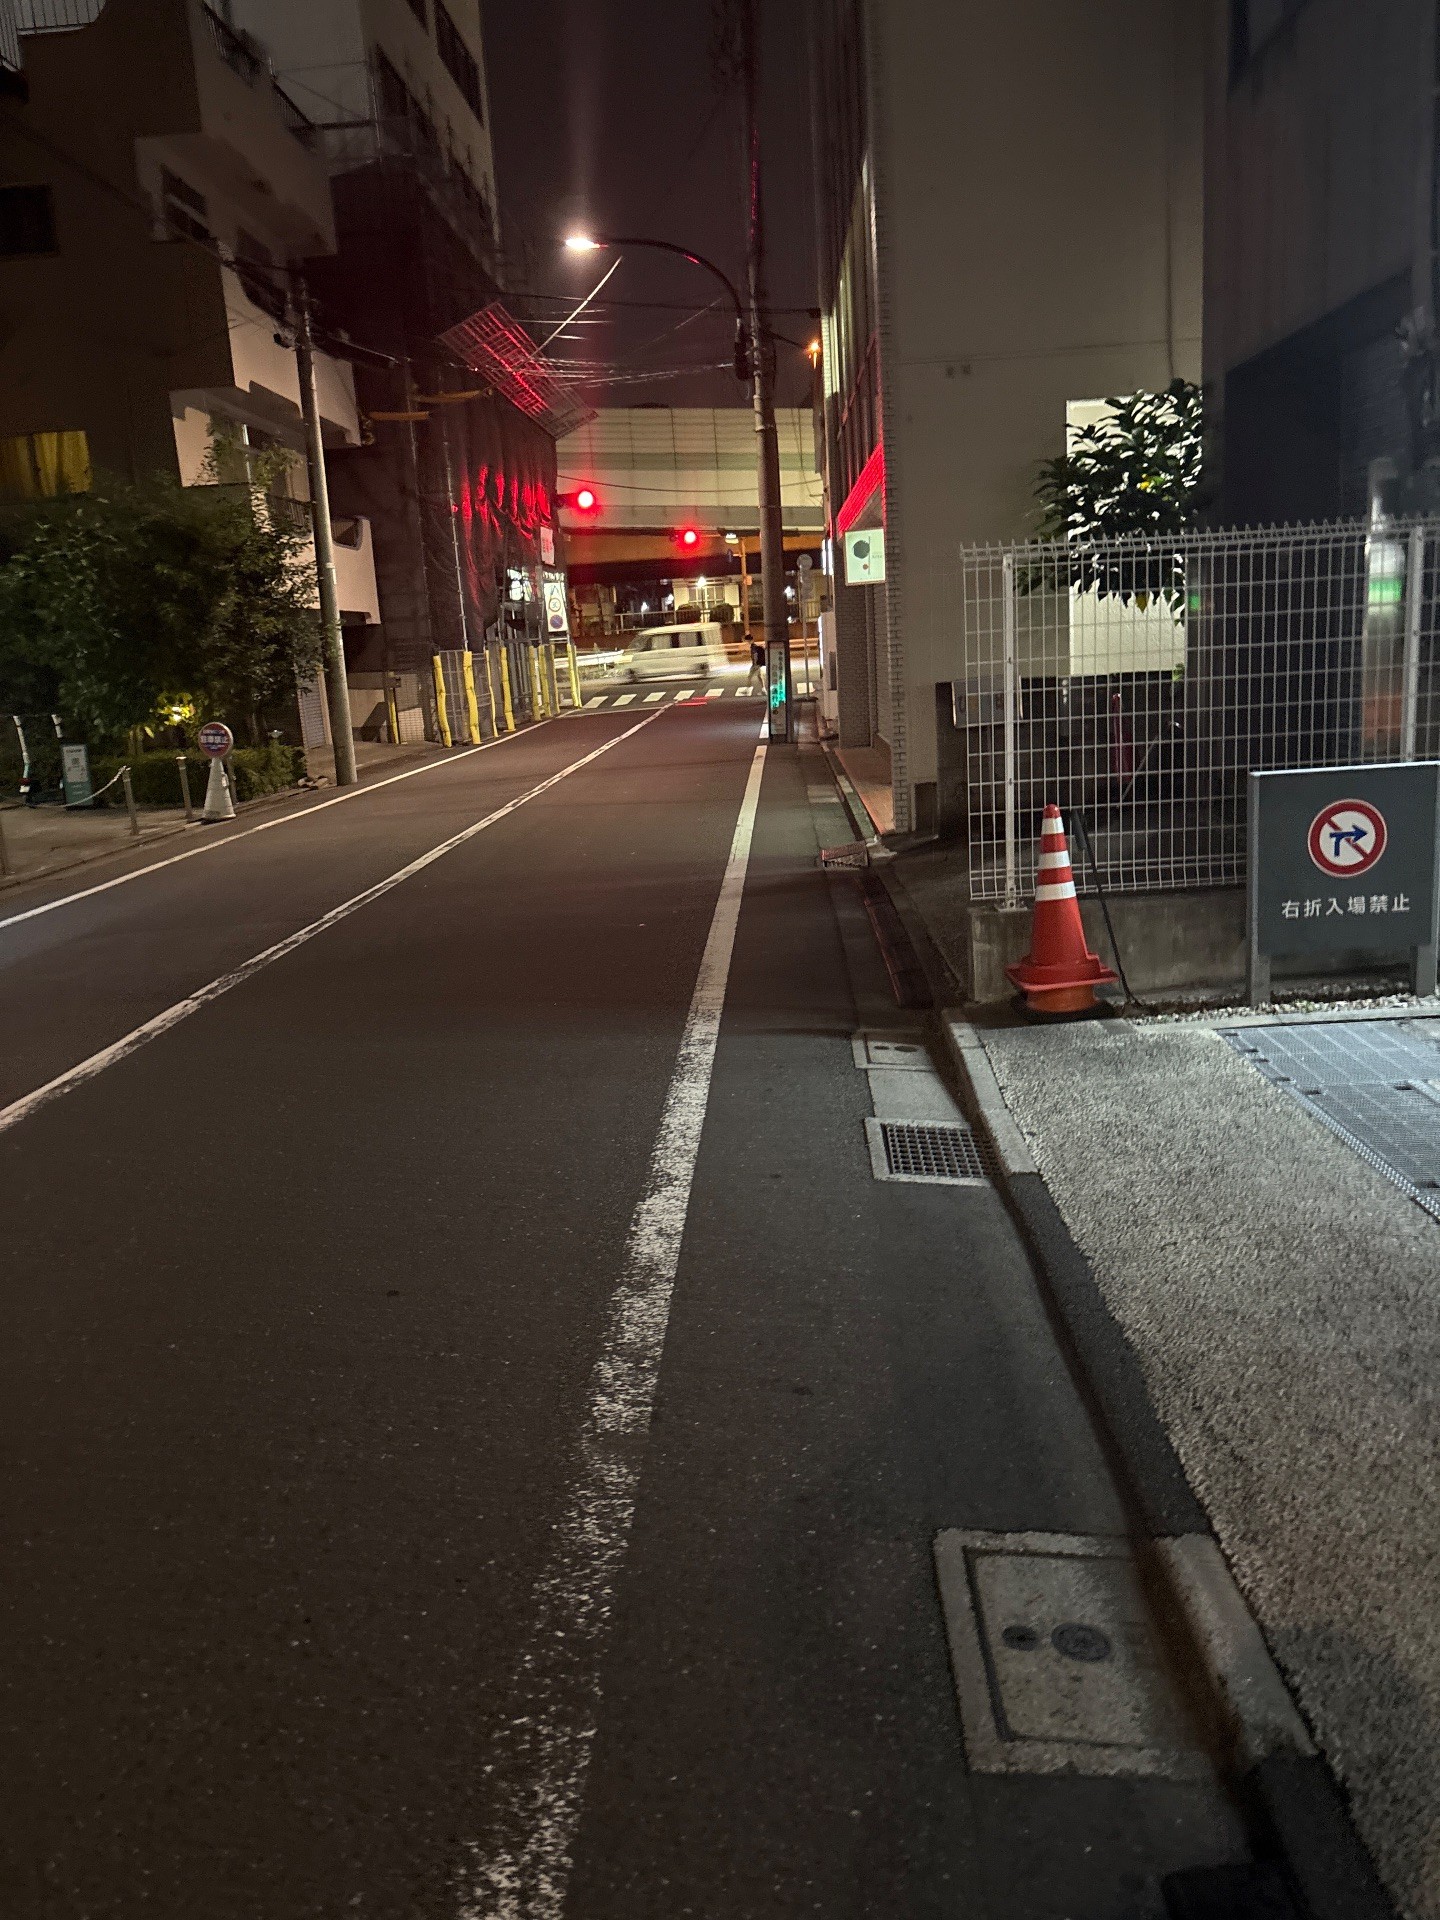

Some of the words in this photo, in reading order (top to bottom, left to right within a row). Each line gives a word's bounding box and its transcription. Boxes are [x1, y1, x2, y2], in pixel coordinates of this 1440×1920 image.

[1281, 893, 1411, 919] 右折入場禁止
